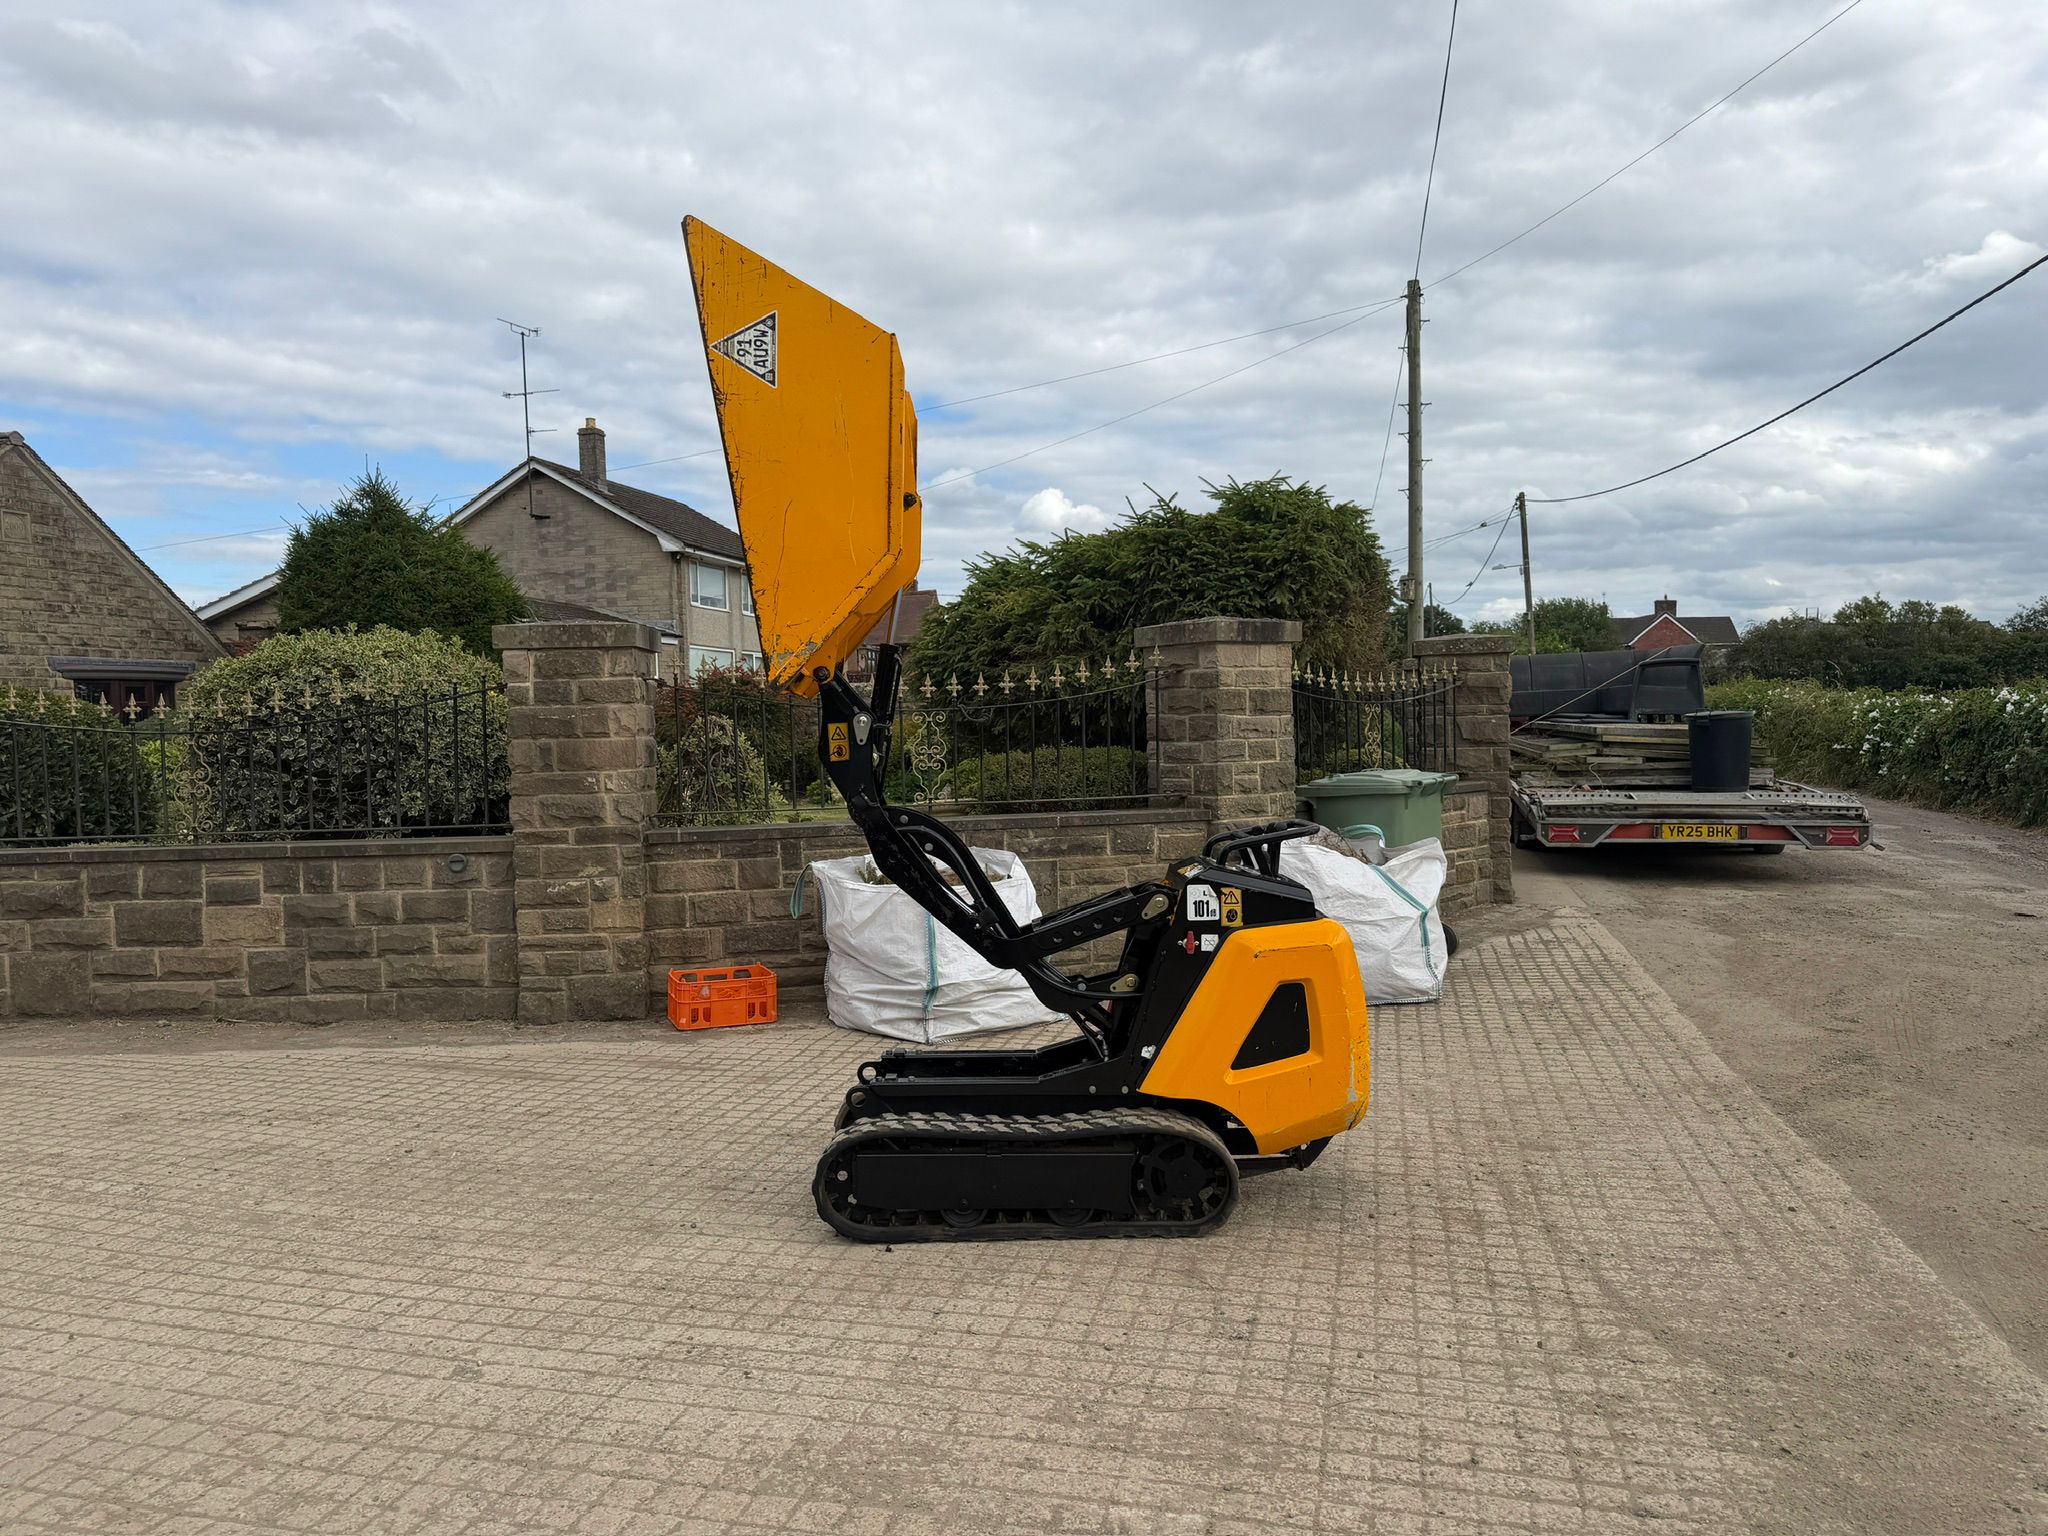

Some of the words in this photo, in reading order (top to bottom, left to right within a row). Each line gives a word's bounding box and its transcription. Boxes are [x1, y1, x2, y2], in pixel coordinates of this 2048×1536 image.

[736, 339, 752, 357] 91
[753, 328, 769, 369] AU9W
[1668, 825, 1703, 838] YR25
[1707, 825, 1733, 838] BHK
[1193, 900, 1209, 917] 101
